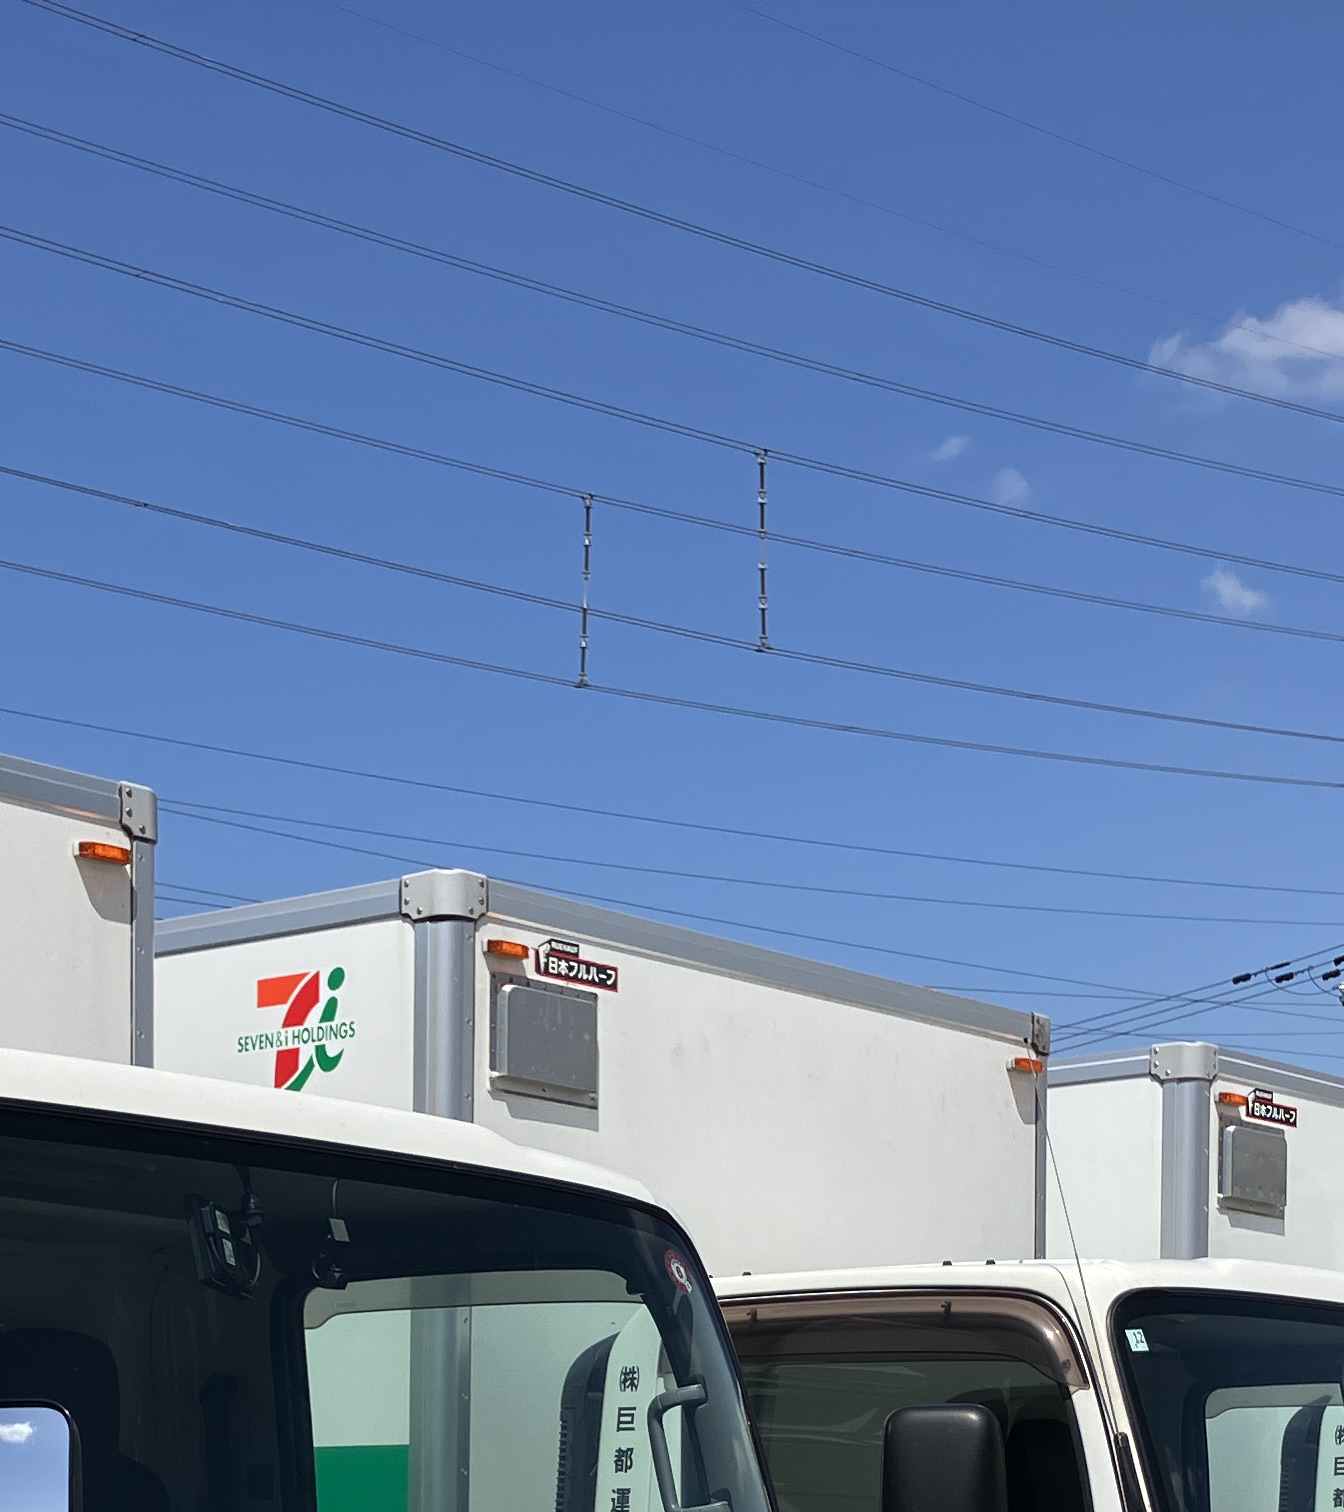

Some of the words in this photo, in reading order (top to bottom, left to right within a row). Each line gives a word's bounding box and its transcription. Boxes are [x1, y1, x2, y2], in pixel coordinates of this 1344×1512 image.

[548, 956, 616, 986] 日本フルハーフ
[292, 1020, 356, 1045] HOLDINGS
